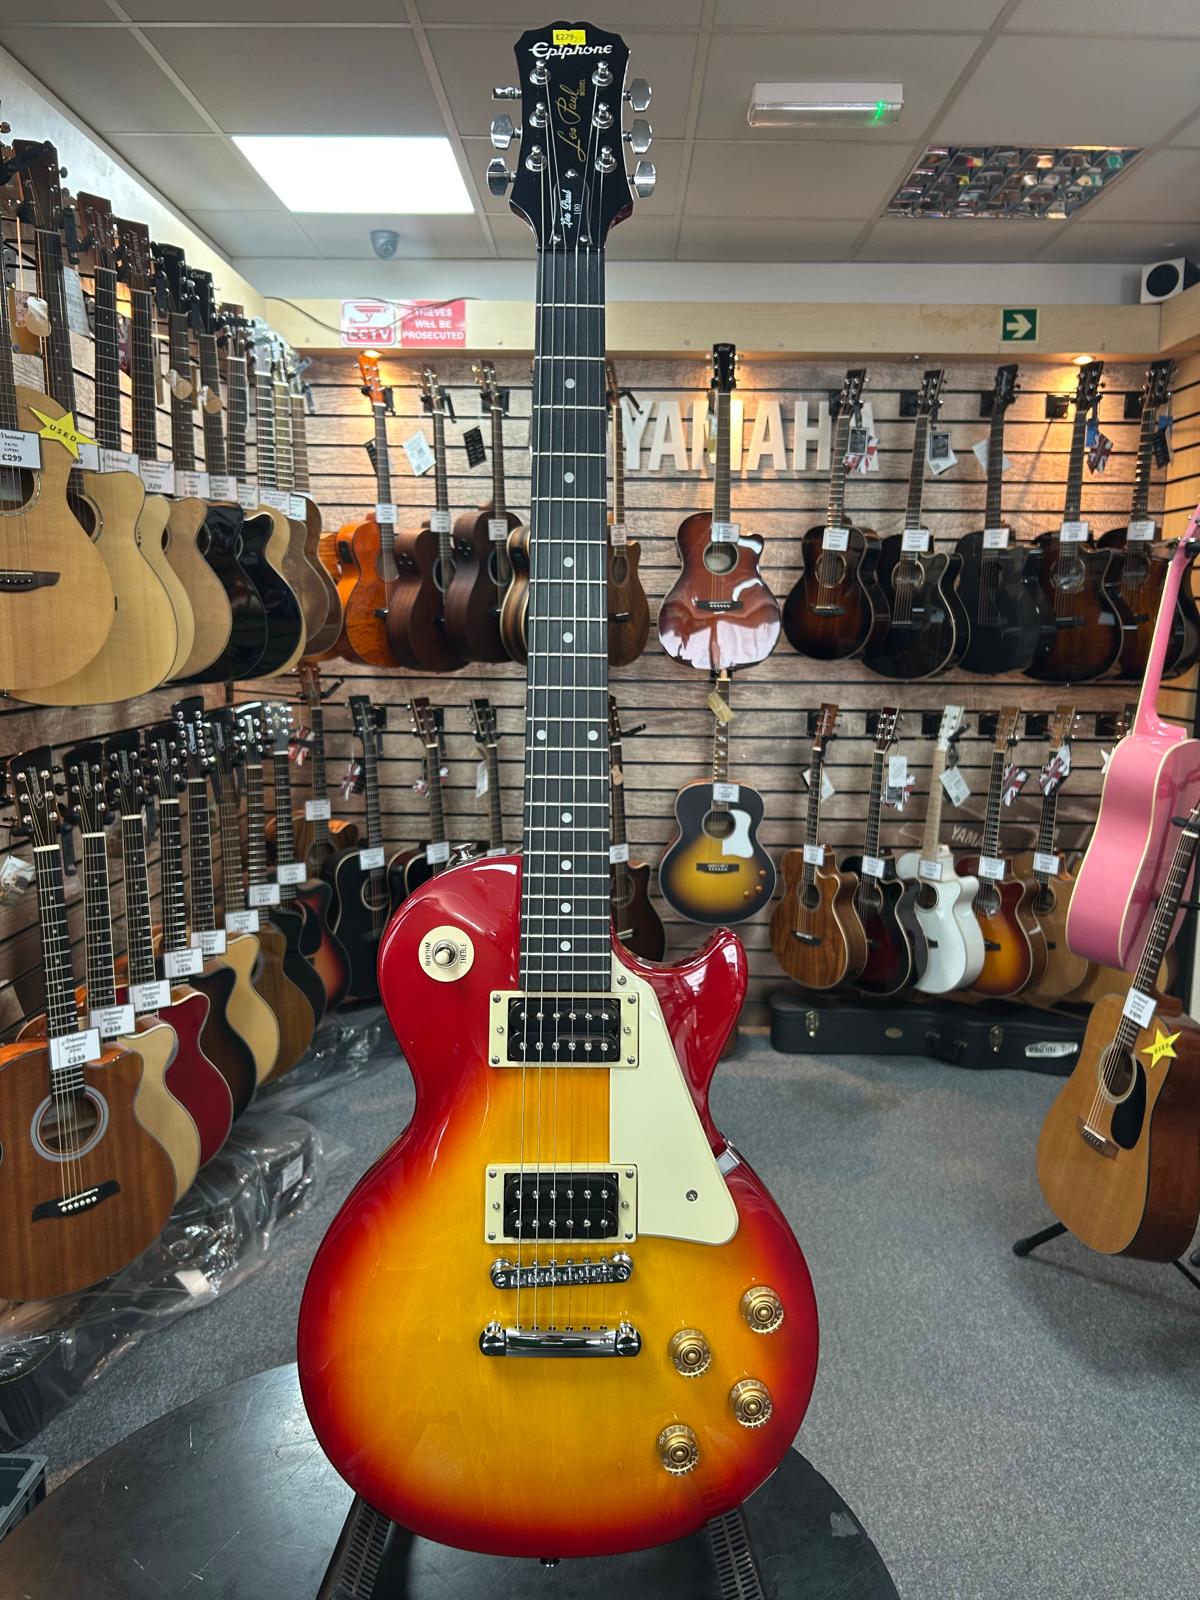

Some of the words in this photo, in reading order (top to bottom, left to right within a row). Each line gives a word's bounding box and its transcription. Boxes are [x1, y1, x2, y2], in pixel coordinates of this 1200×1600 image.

[528, 42, 613, 60] Epiphone
[557, 84, 581, 125] Paul
[557, 127, 586, 162] Les
[560, 189, 572, 211] Paul
[573, 203, 582, 215] 100
[415, 320, 437, 329] WILL
[438, 320, 453, 329] BE
[348, 328, 391, 340] CCTV
[402, 331, 465, 340] PROSECUTED
[49, 423, 77, 442] USED
